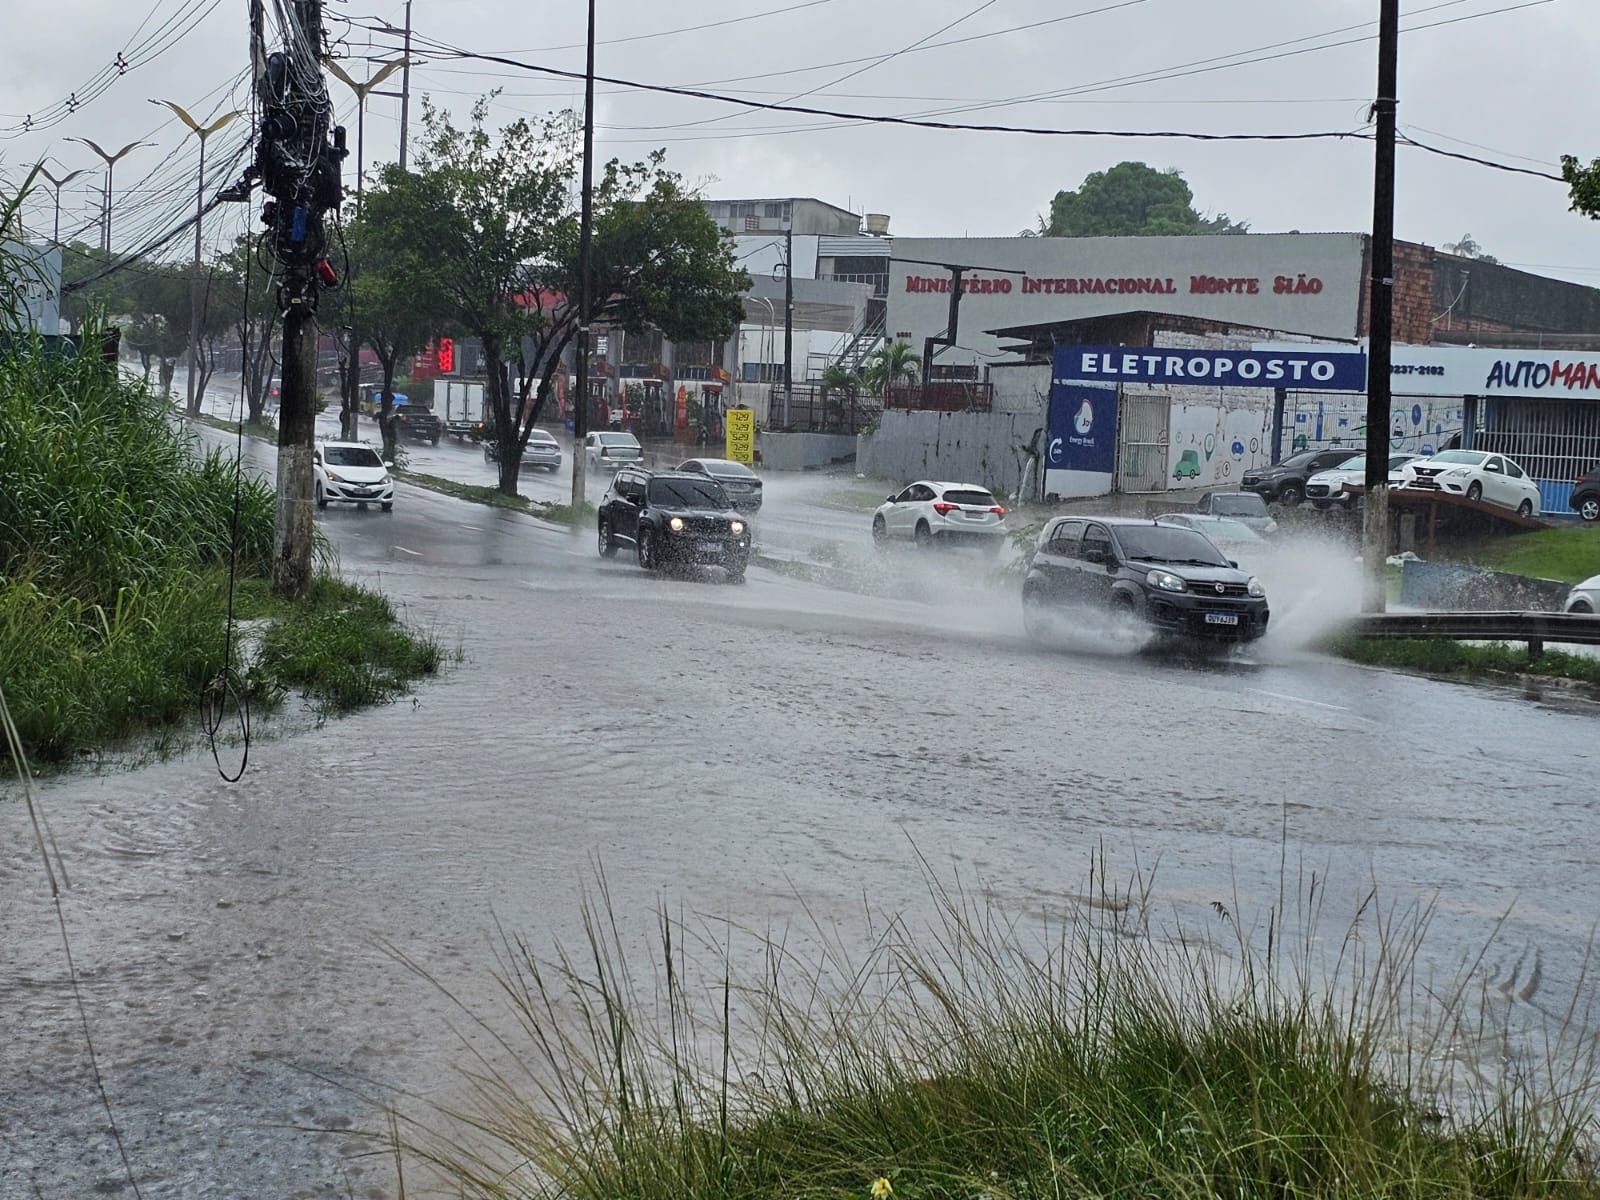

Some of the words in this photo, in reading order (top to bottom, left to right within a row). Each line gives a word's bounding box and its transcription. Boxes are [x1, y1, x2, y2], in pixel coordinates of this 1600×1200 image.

[905, 274, 1012, 294] MINISTÉRIO
[1021, 276, 1177, 294] INTERNACIONAL
[1189, 275, 1260, 294] MONTE
[1273, 273, 1323, 295] SIÃO
[1081, 353, 1335, 381] ELETROPOSTO
